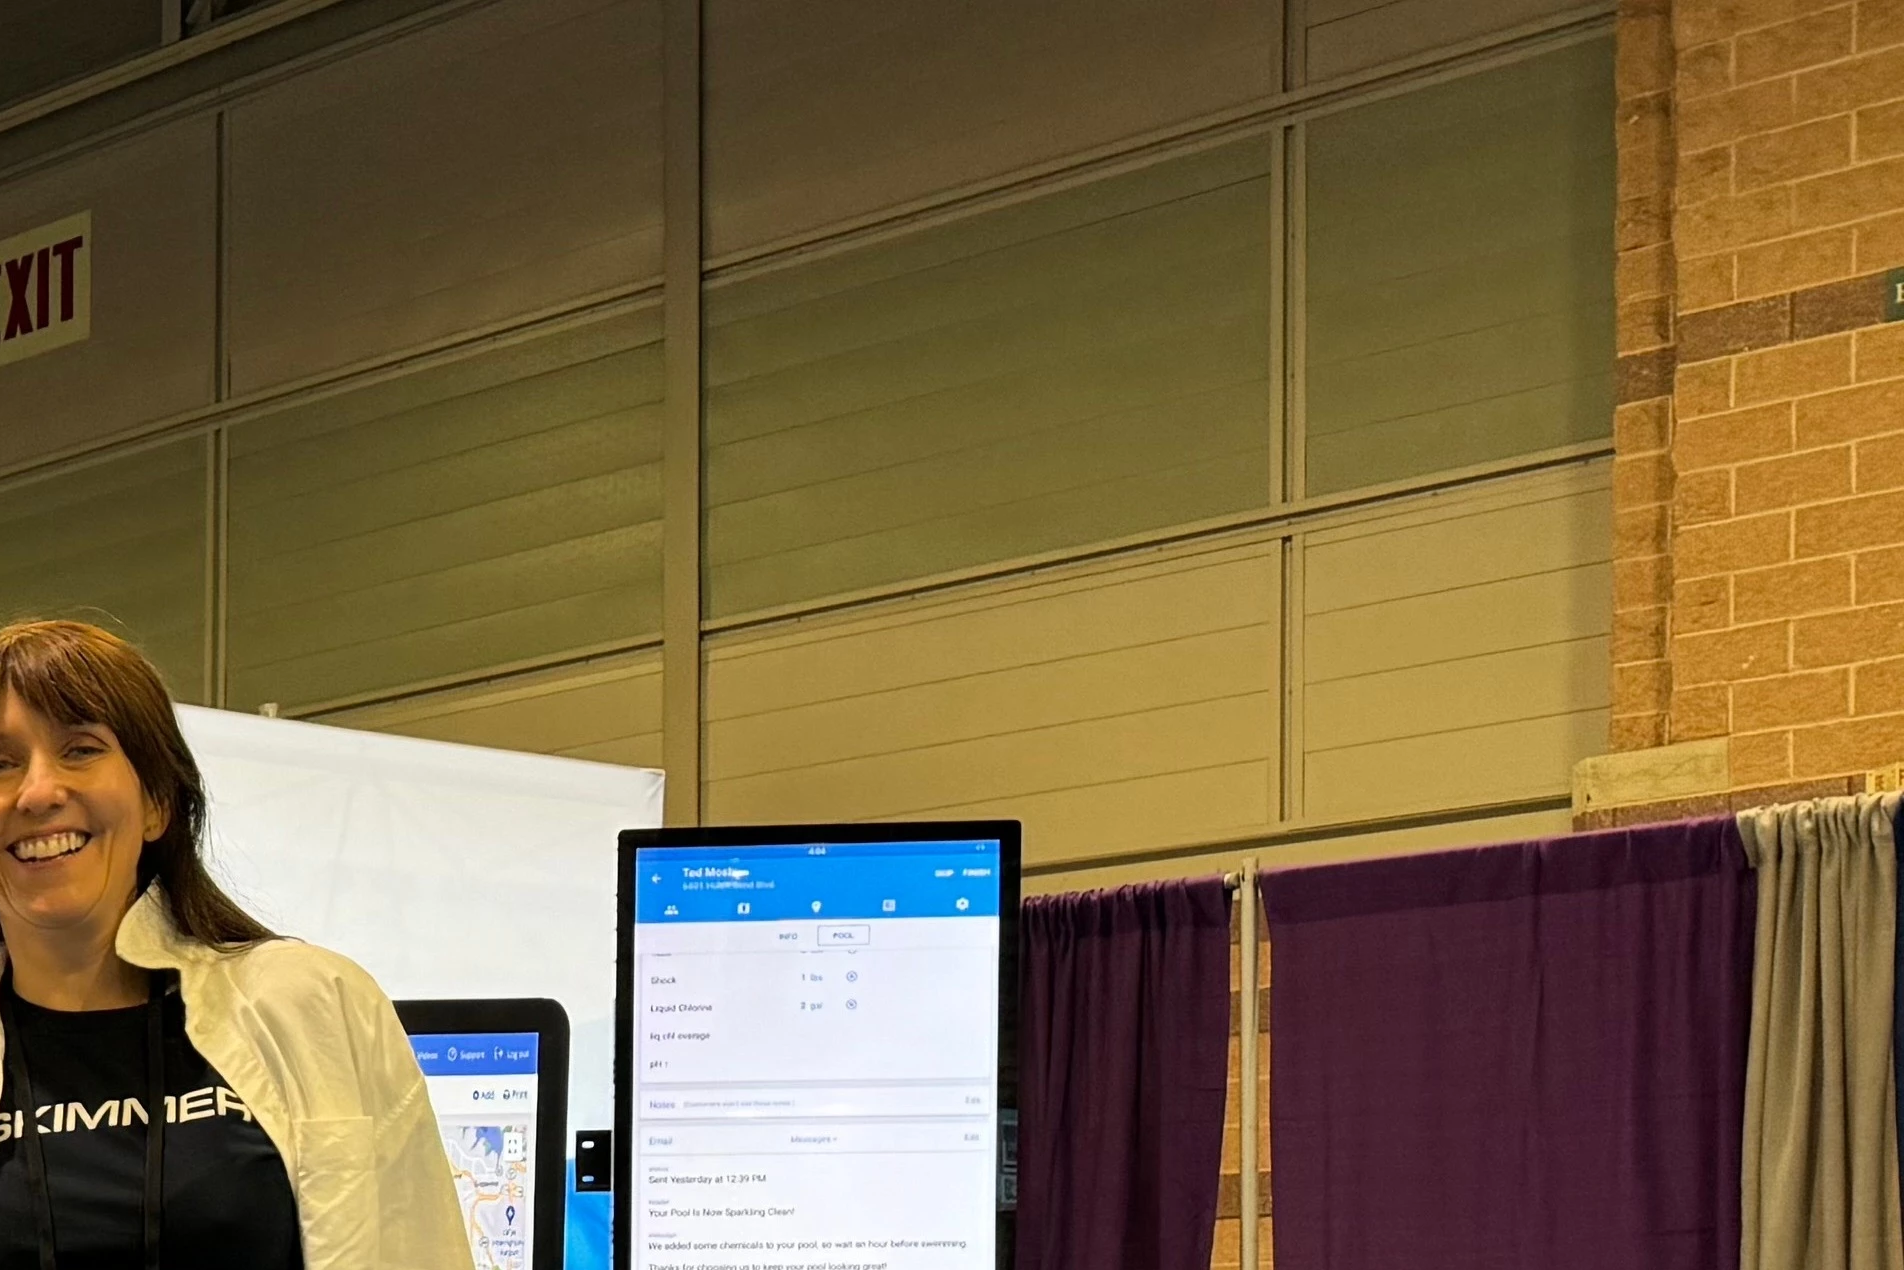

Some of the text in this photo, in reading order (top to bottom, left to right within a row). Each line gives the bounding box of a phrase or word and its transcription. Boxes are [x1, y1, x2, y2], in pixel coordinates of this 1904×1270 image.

[682, 867, 702, 877] Ted
[650, 1004, 676, 1013] Liquid
[678, 1003, 712, 1012] Chlorine
[459, 1050, 485, 1061] Support
[506, 1050, 518, 1060] Log
[481, 1090, 528, 1100] Add Print
[649, 1137, 673, 1145] Email
[649, 1175, 668, 1184] Sent
[670, 1175, 713, 1185] Yesterday
[715, 1175, 723, 1183] at
[752, 1174, 766, 1182] PM
[649, 1209, 668, 1217] Your
[670, 1208, 690, 1217] Pool
[703, 1208, 722, 1216] Now
[725, 1207, 765, 1218] Sparkling
[649, 1242, 662, 1250] We
[665, 1241, 691, 1250] added
[719, 1241, 763, 1249] chemicals
[766, 1241, 774, 1249] to
[776, 1242, 795, 1251] your
[835, 1240, 853, 1248] wait
[868, 1240, 888, 1248] hour
[891, 1239, 918, 1248] before
